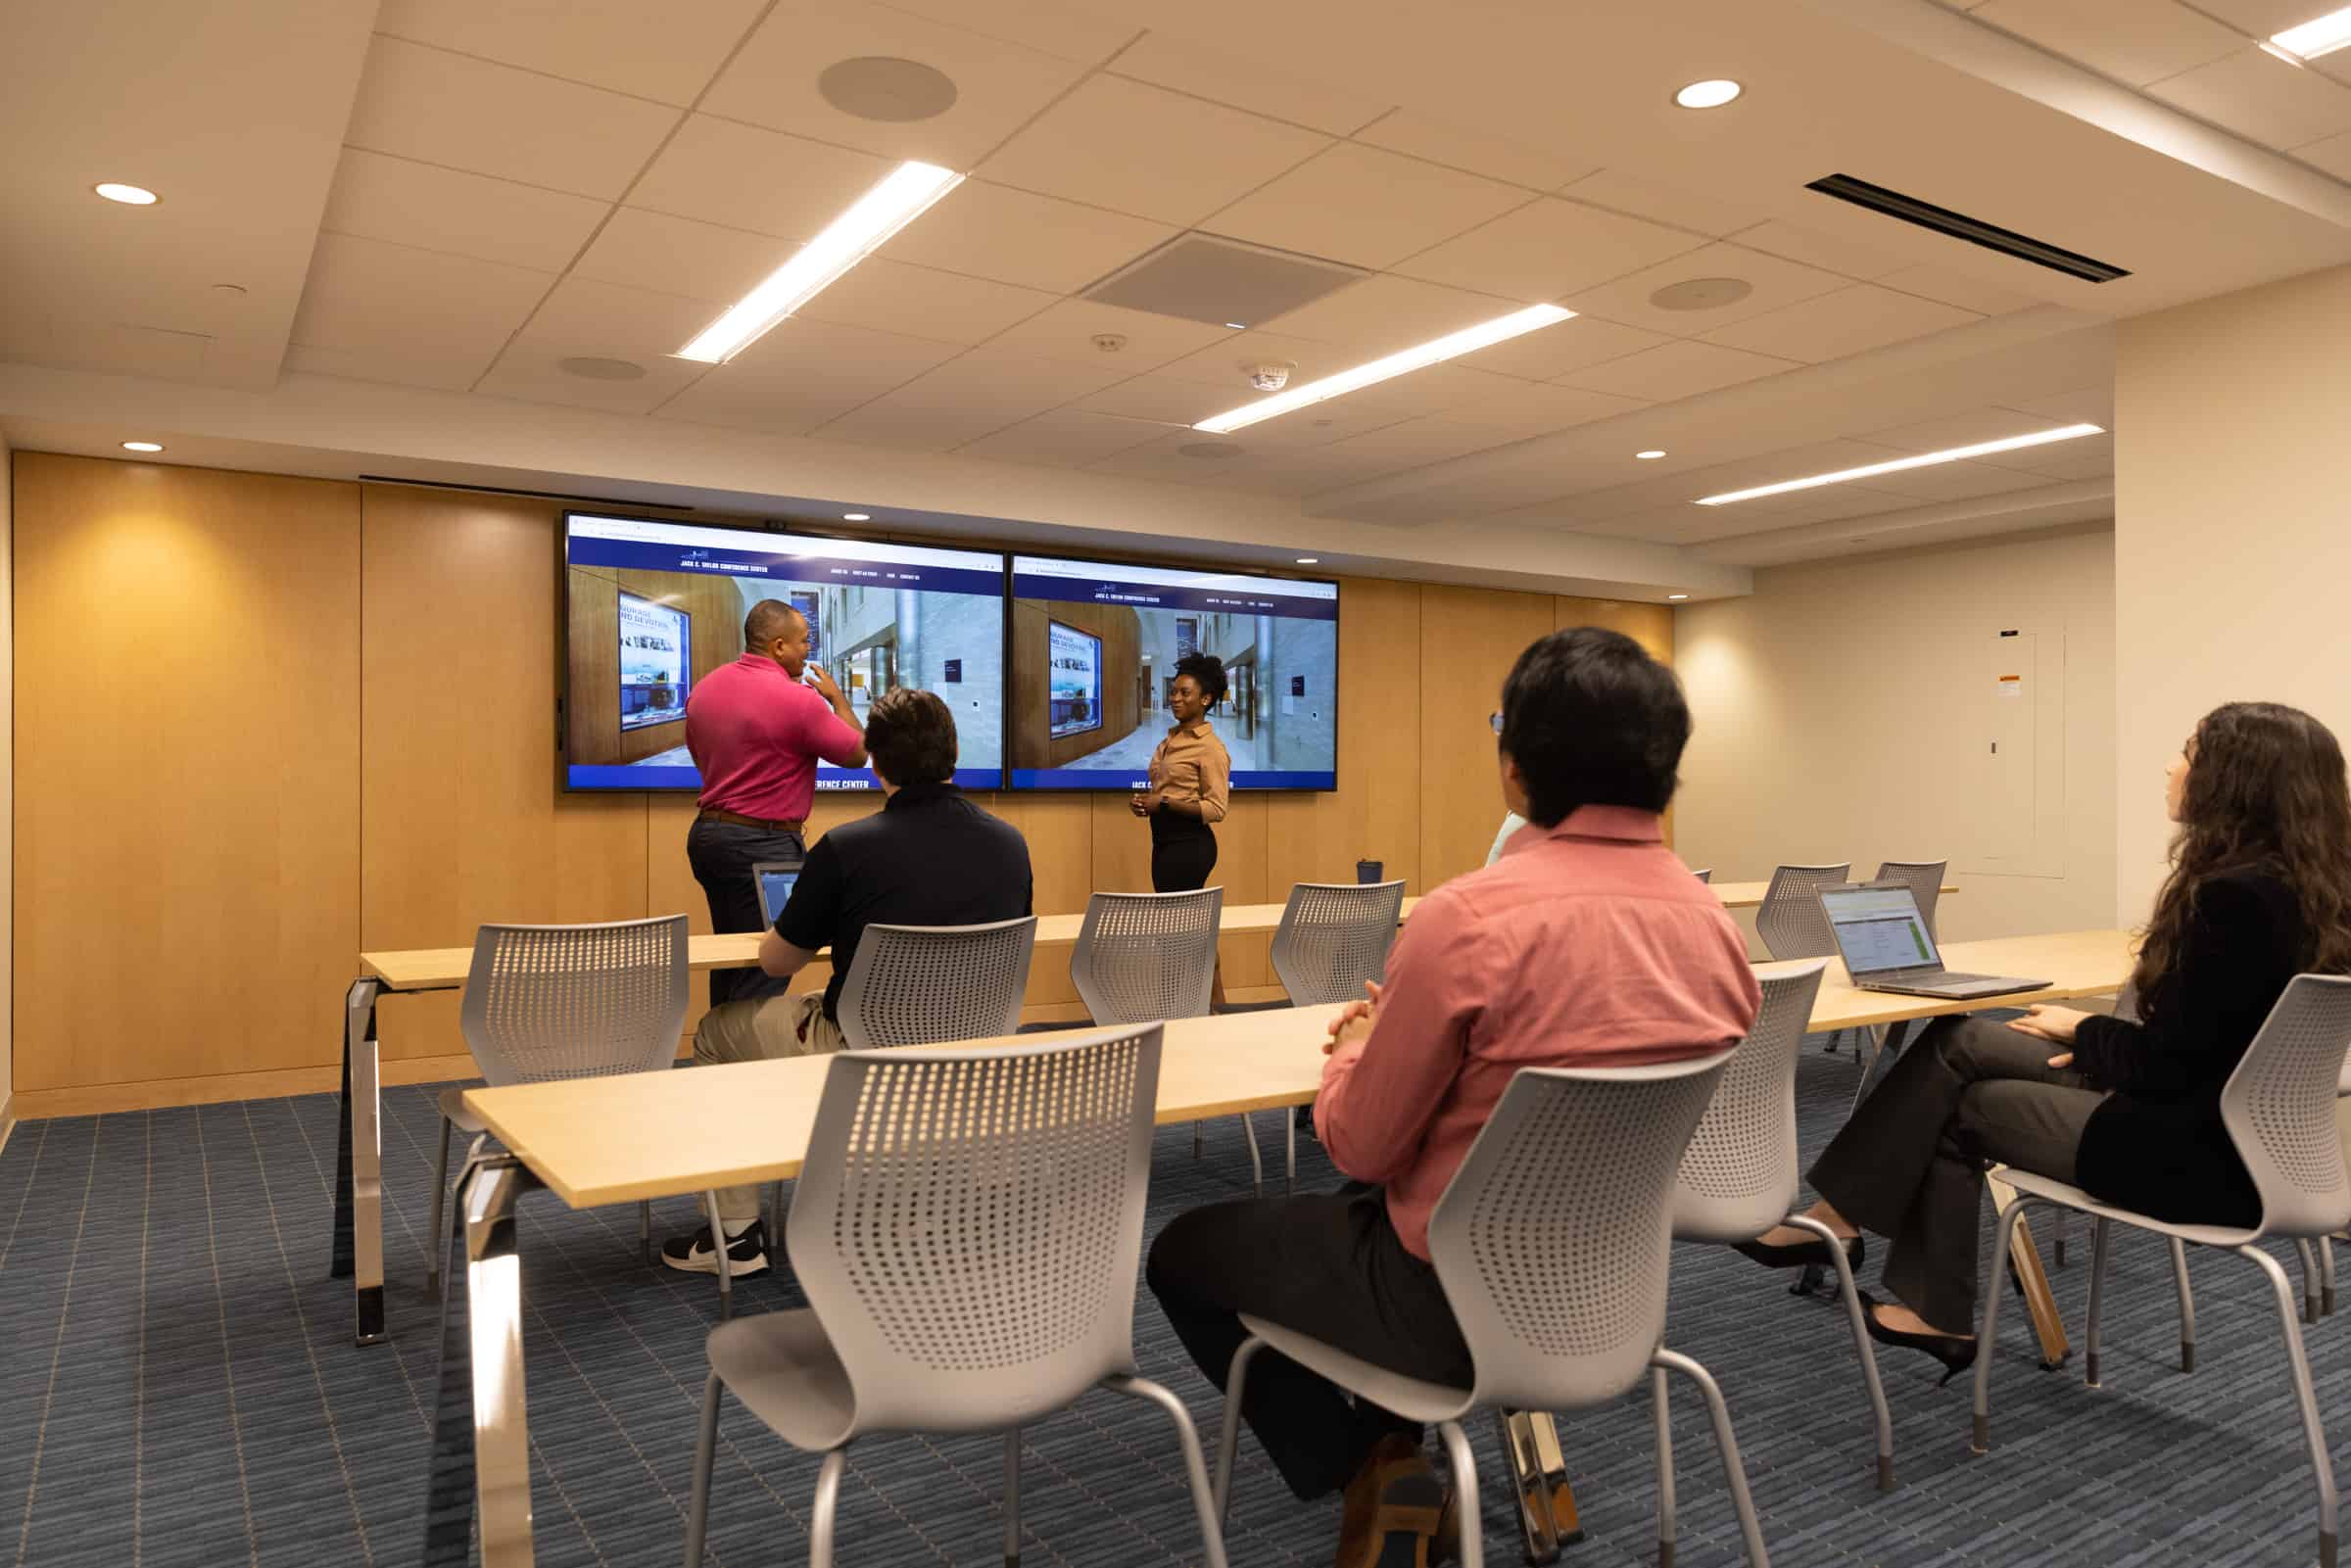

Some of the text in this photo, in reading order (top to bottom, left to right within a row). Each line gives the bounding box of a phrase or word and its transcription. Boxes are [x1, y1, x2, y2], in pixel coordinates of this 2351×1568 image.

[815, 780, 869, 790] ERENCE CENTER
[1132, 781, 1146, 789] JACK
